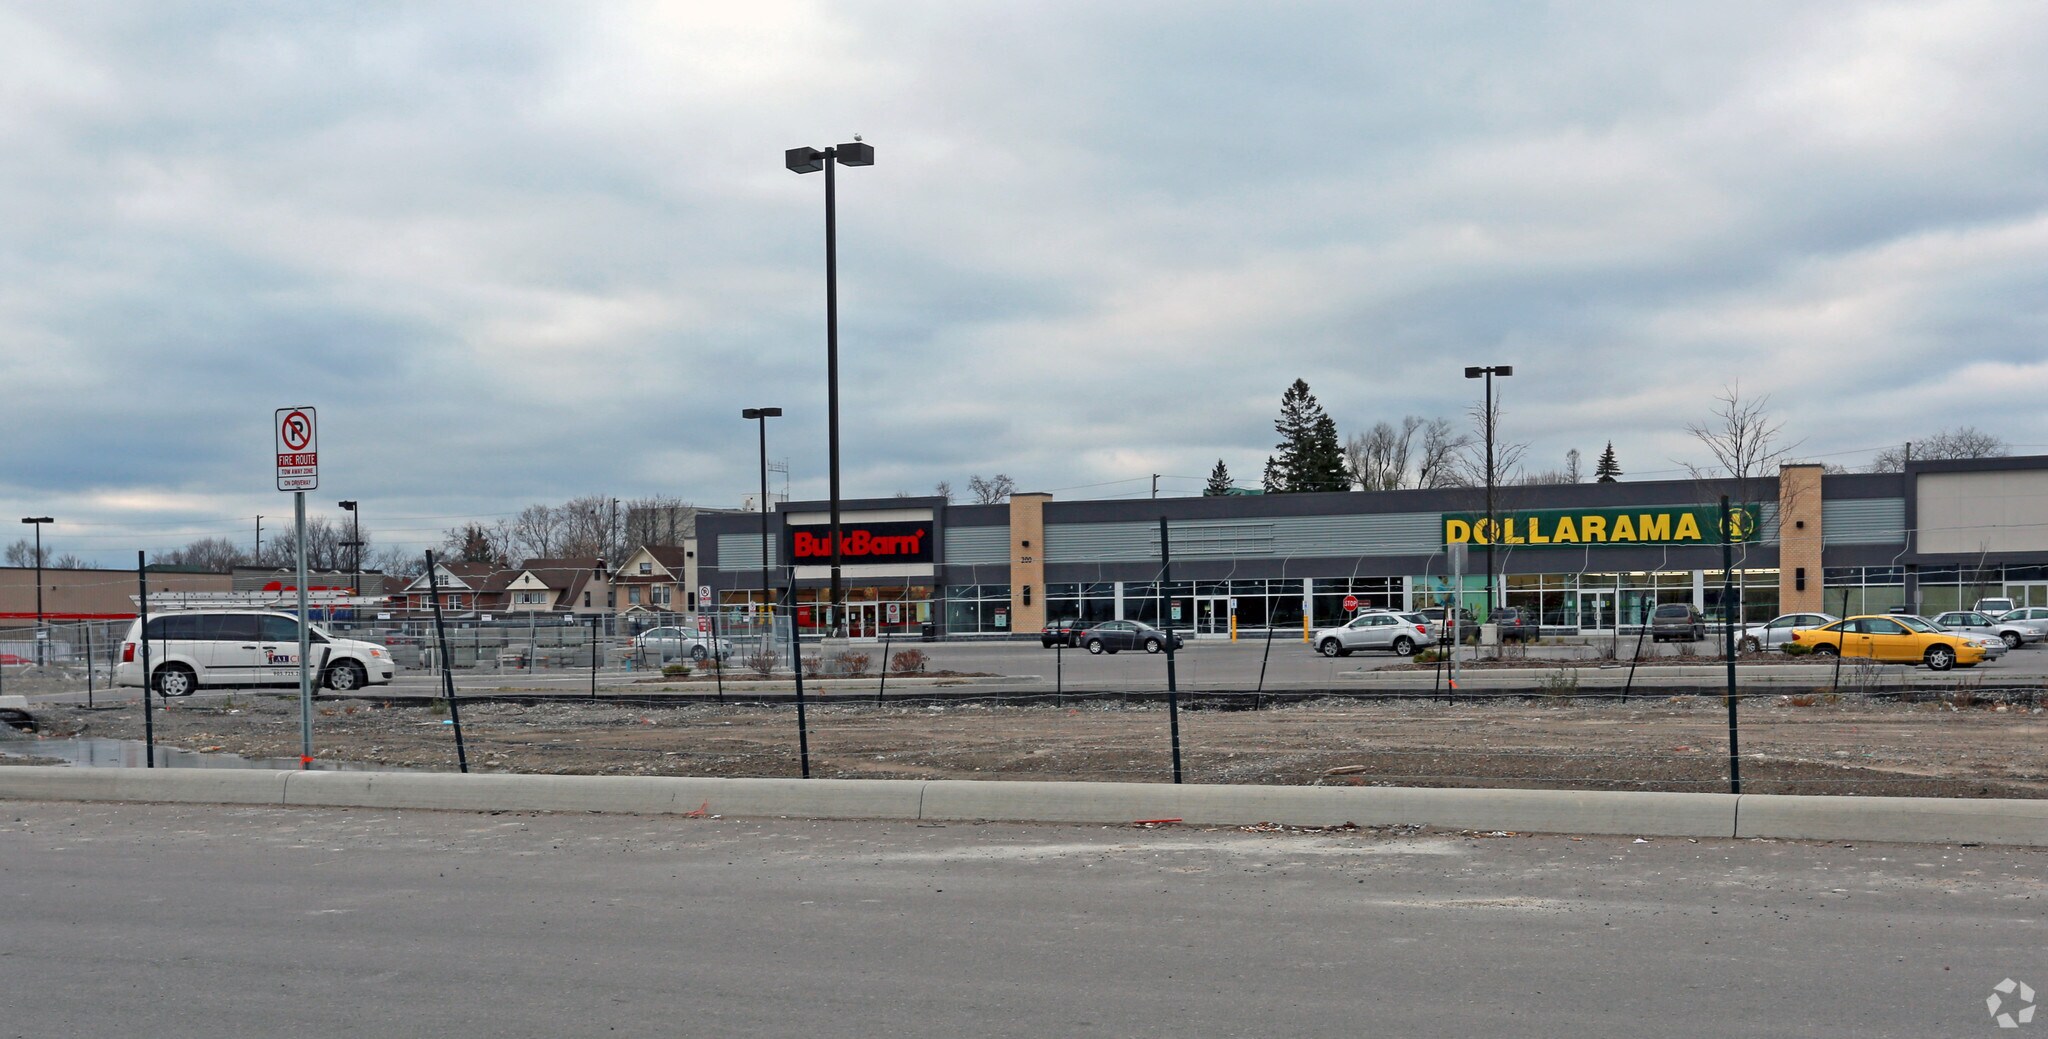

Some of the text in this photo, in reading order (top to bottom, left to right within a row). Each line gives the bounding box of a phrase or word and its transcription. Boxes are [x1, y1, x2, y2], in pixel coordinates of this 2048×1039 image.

[279, 454, 315, 466] FIRE ROUTE
[1446, 512, 1701, 545] DOLLARAMA
